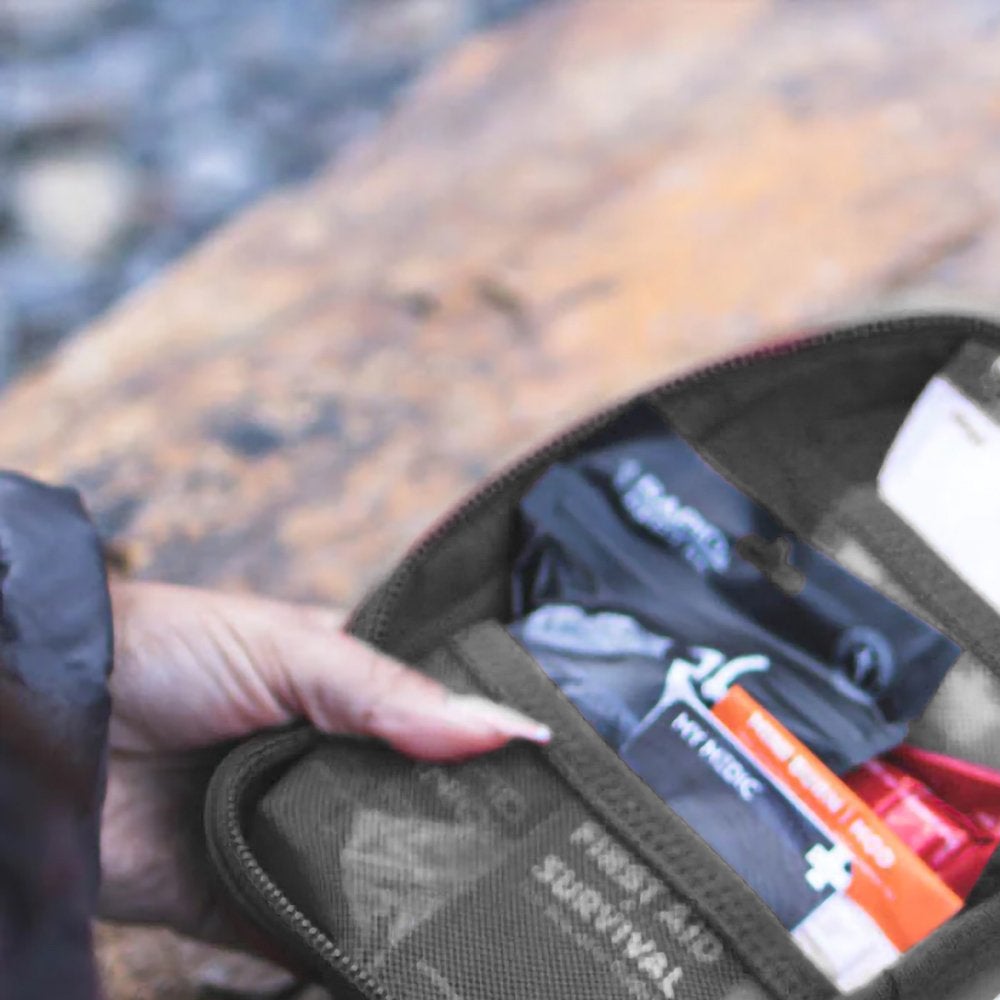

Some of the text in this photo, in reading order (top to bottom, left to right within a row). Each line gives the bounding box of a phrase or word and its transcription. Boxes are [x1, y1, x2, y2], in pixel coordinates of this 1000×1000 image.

[672, 711, 707, 747] MY
[699, 738, 762, 801] MEDIC
[531, 854, 683, 1000] SURVIVAL
[570, 820, 668, 905] FIRST
[655, 904, 723, 963] AID
